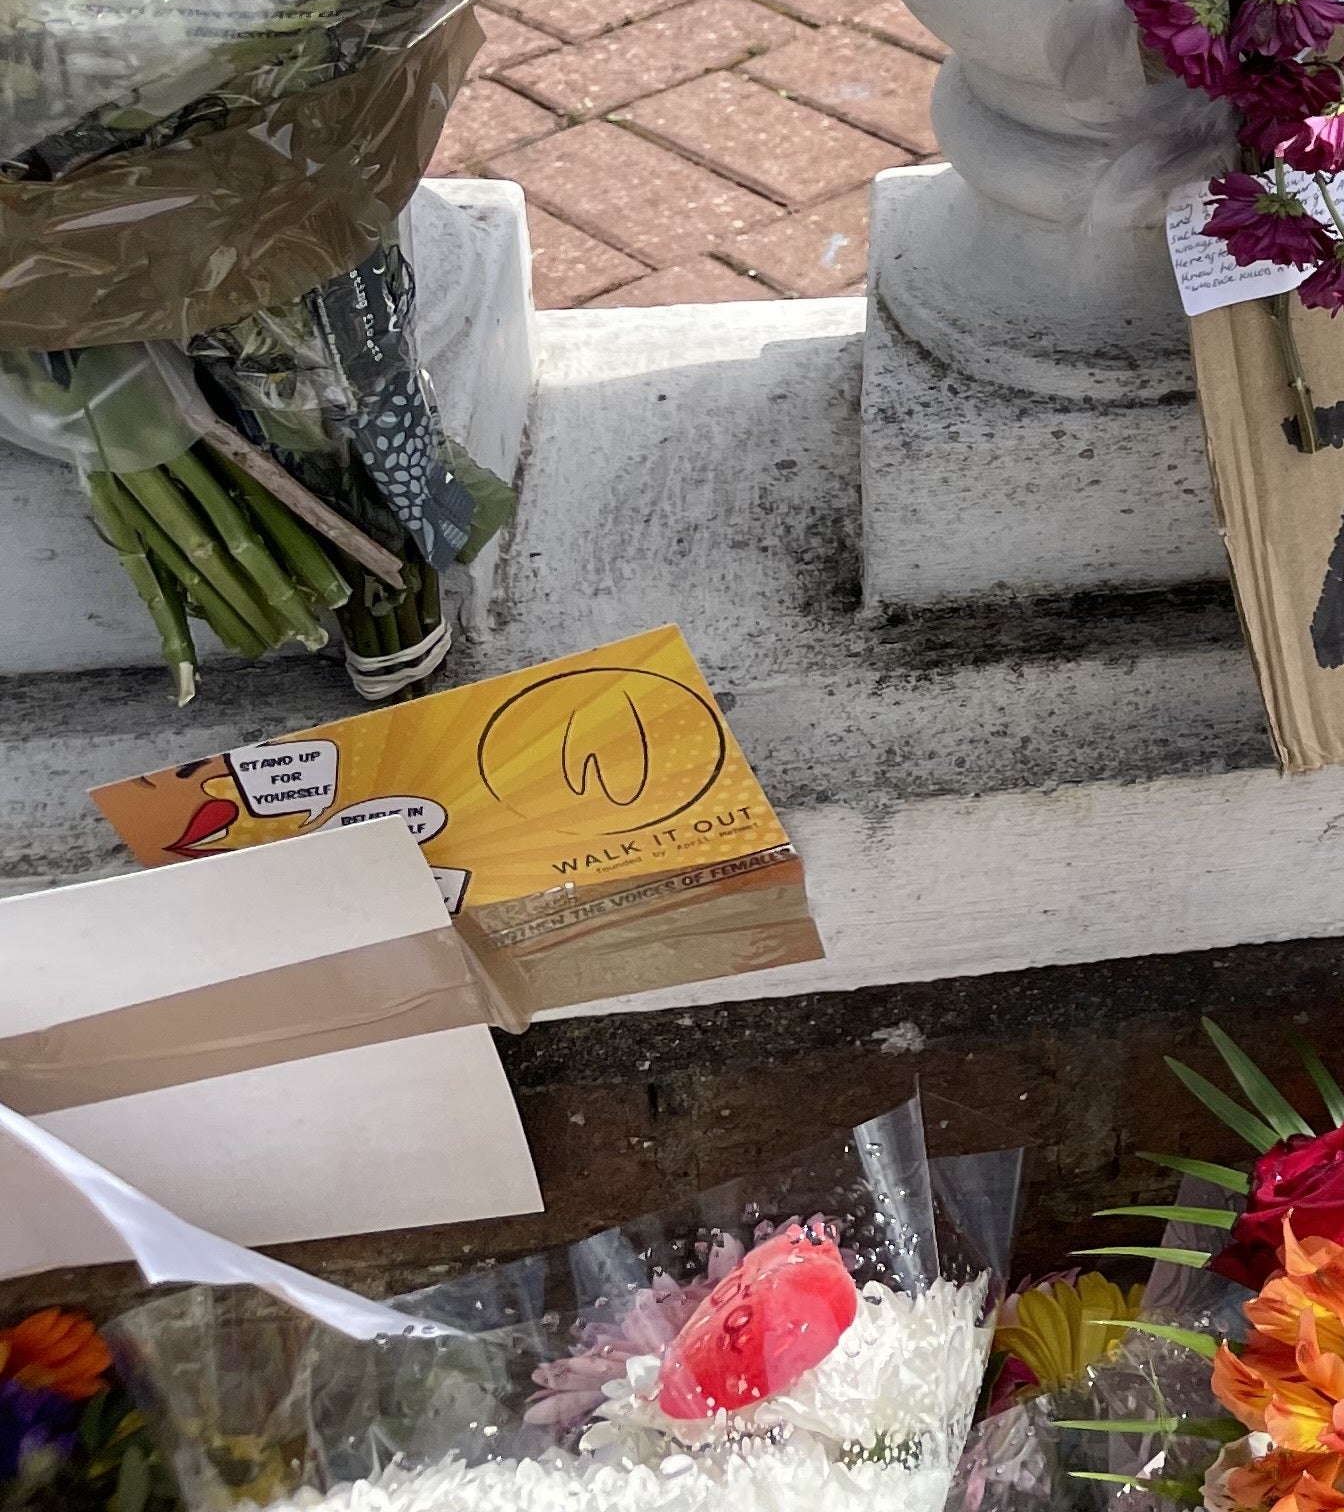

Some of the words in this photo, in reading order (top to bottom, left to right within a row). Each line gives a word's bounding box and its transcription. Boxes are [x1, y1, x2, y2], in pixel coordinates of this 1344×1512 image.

[239, 754, 294, 772] STAND
[298, 750, 322, 763] UP
[270, 771, 303, 785] FOR
[252, 783, 334, 806] YOURSELF
[407, 805, 425, 818] IN
[551, 839, 643, 875] WALK
[652, 828, 679, 847] IT
[693, 806, 751, 834] OUT
[570, 902, 607, 922] THE
[608, 879, 678, 908] VOICES
[681, 870, 706, 887] OF
[708, 846, 792, 880] FEMALES
